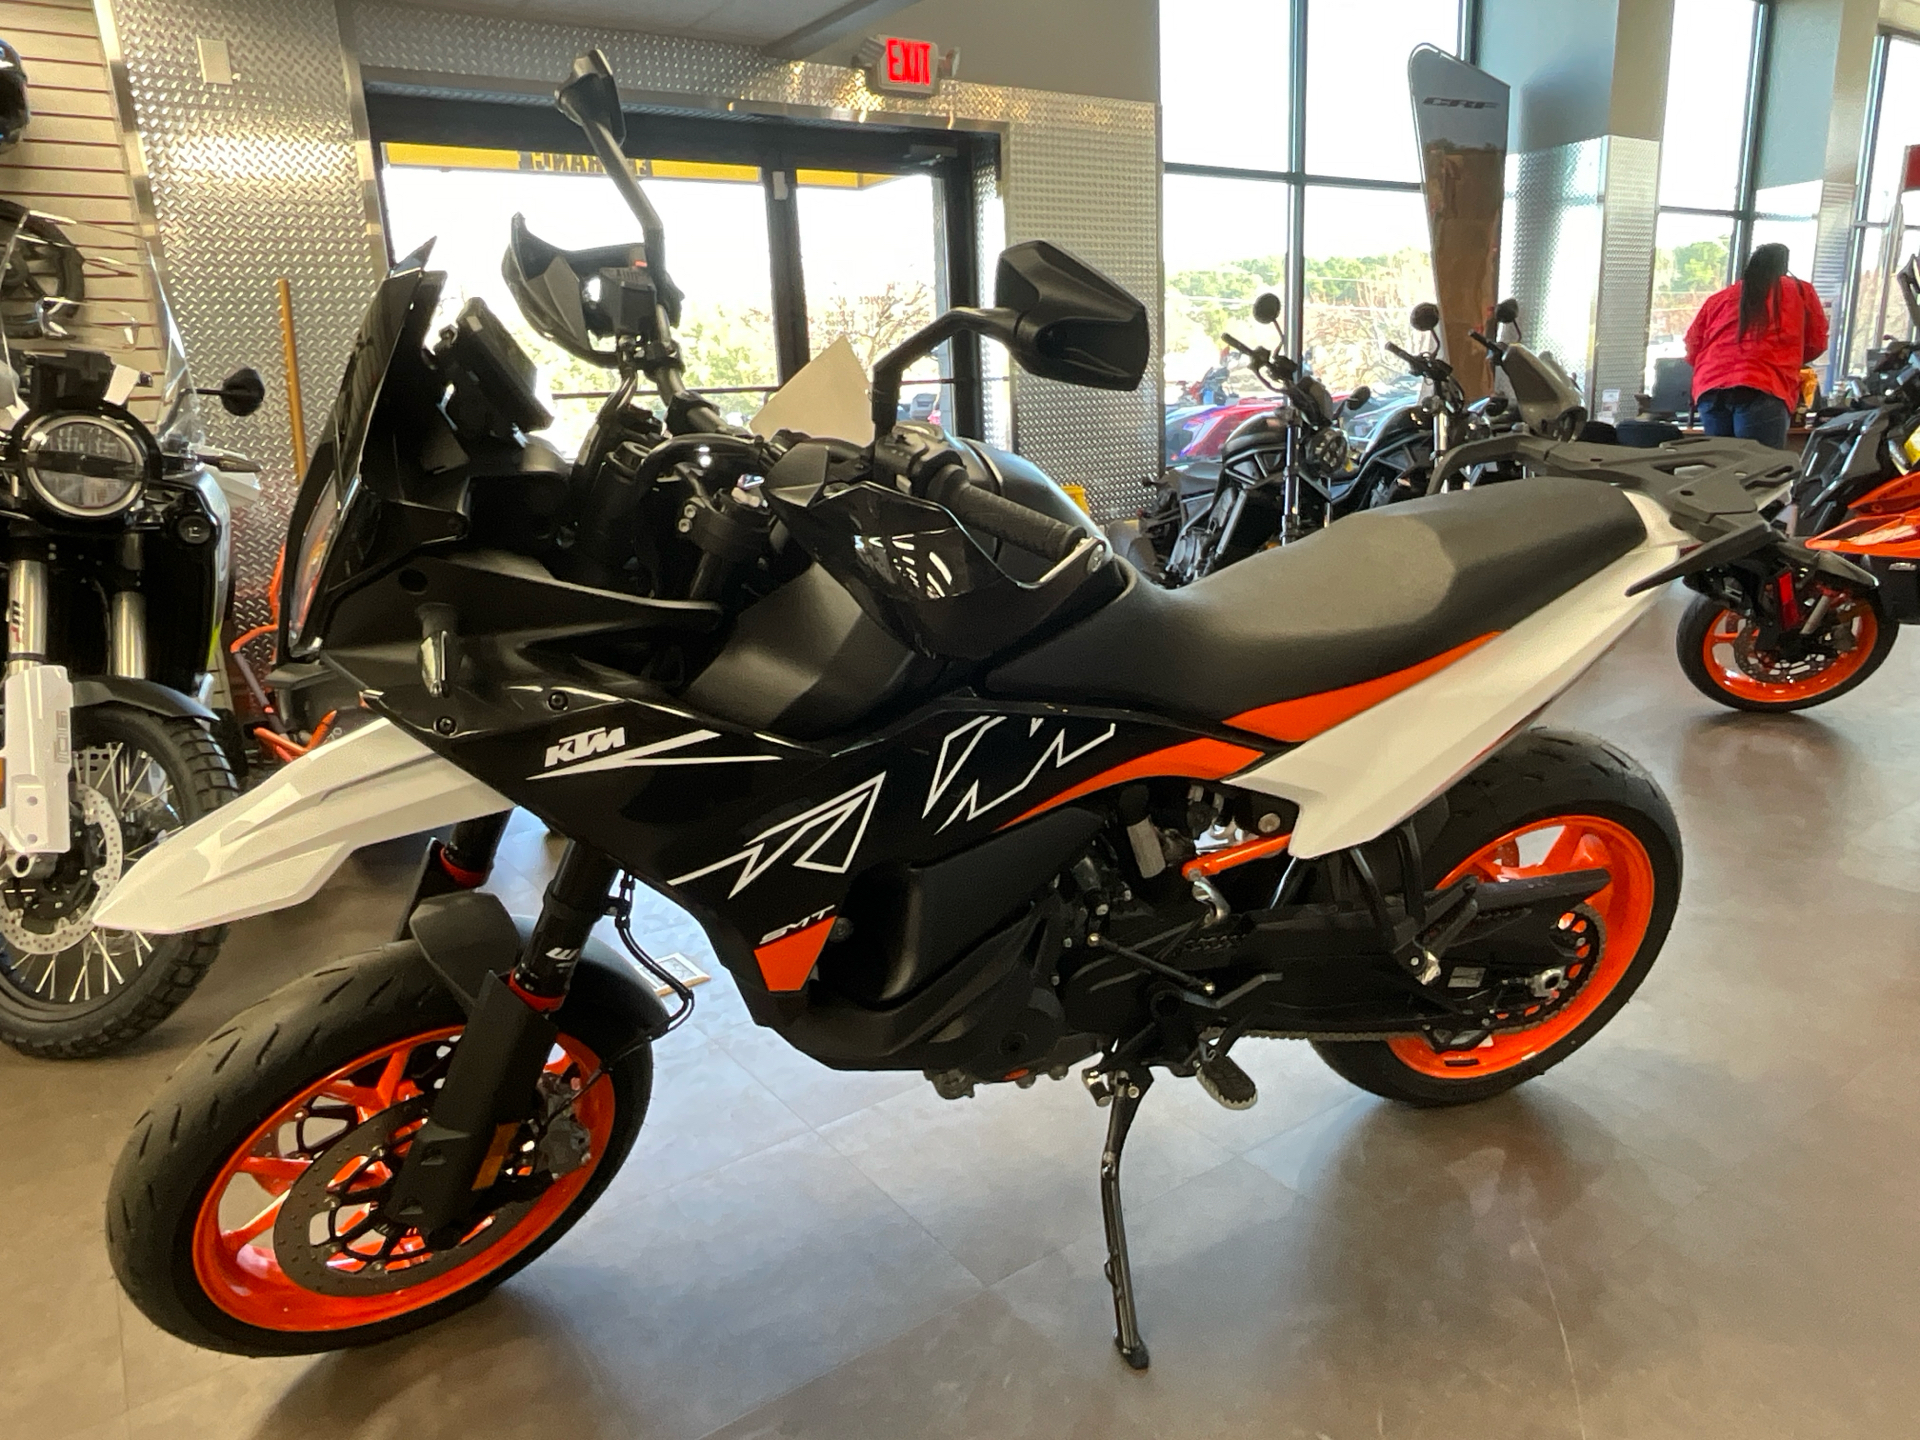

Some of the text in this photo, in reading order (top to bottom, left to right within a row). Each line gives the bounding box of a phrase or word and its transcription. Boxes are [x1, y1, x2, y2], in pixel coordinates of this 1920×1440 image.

[886, 37, 931, 86] EXIT
[544, 726, 625, 768] KTM
[759, 904, 835, 945] SMT
